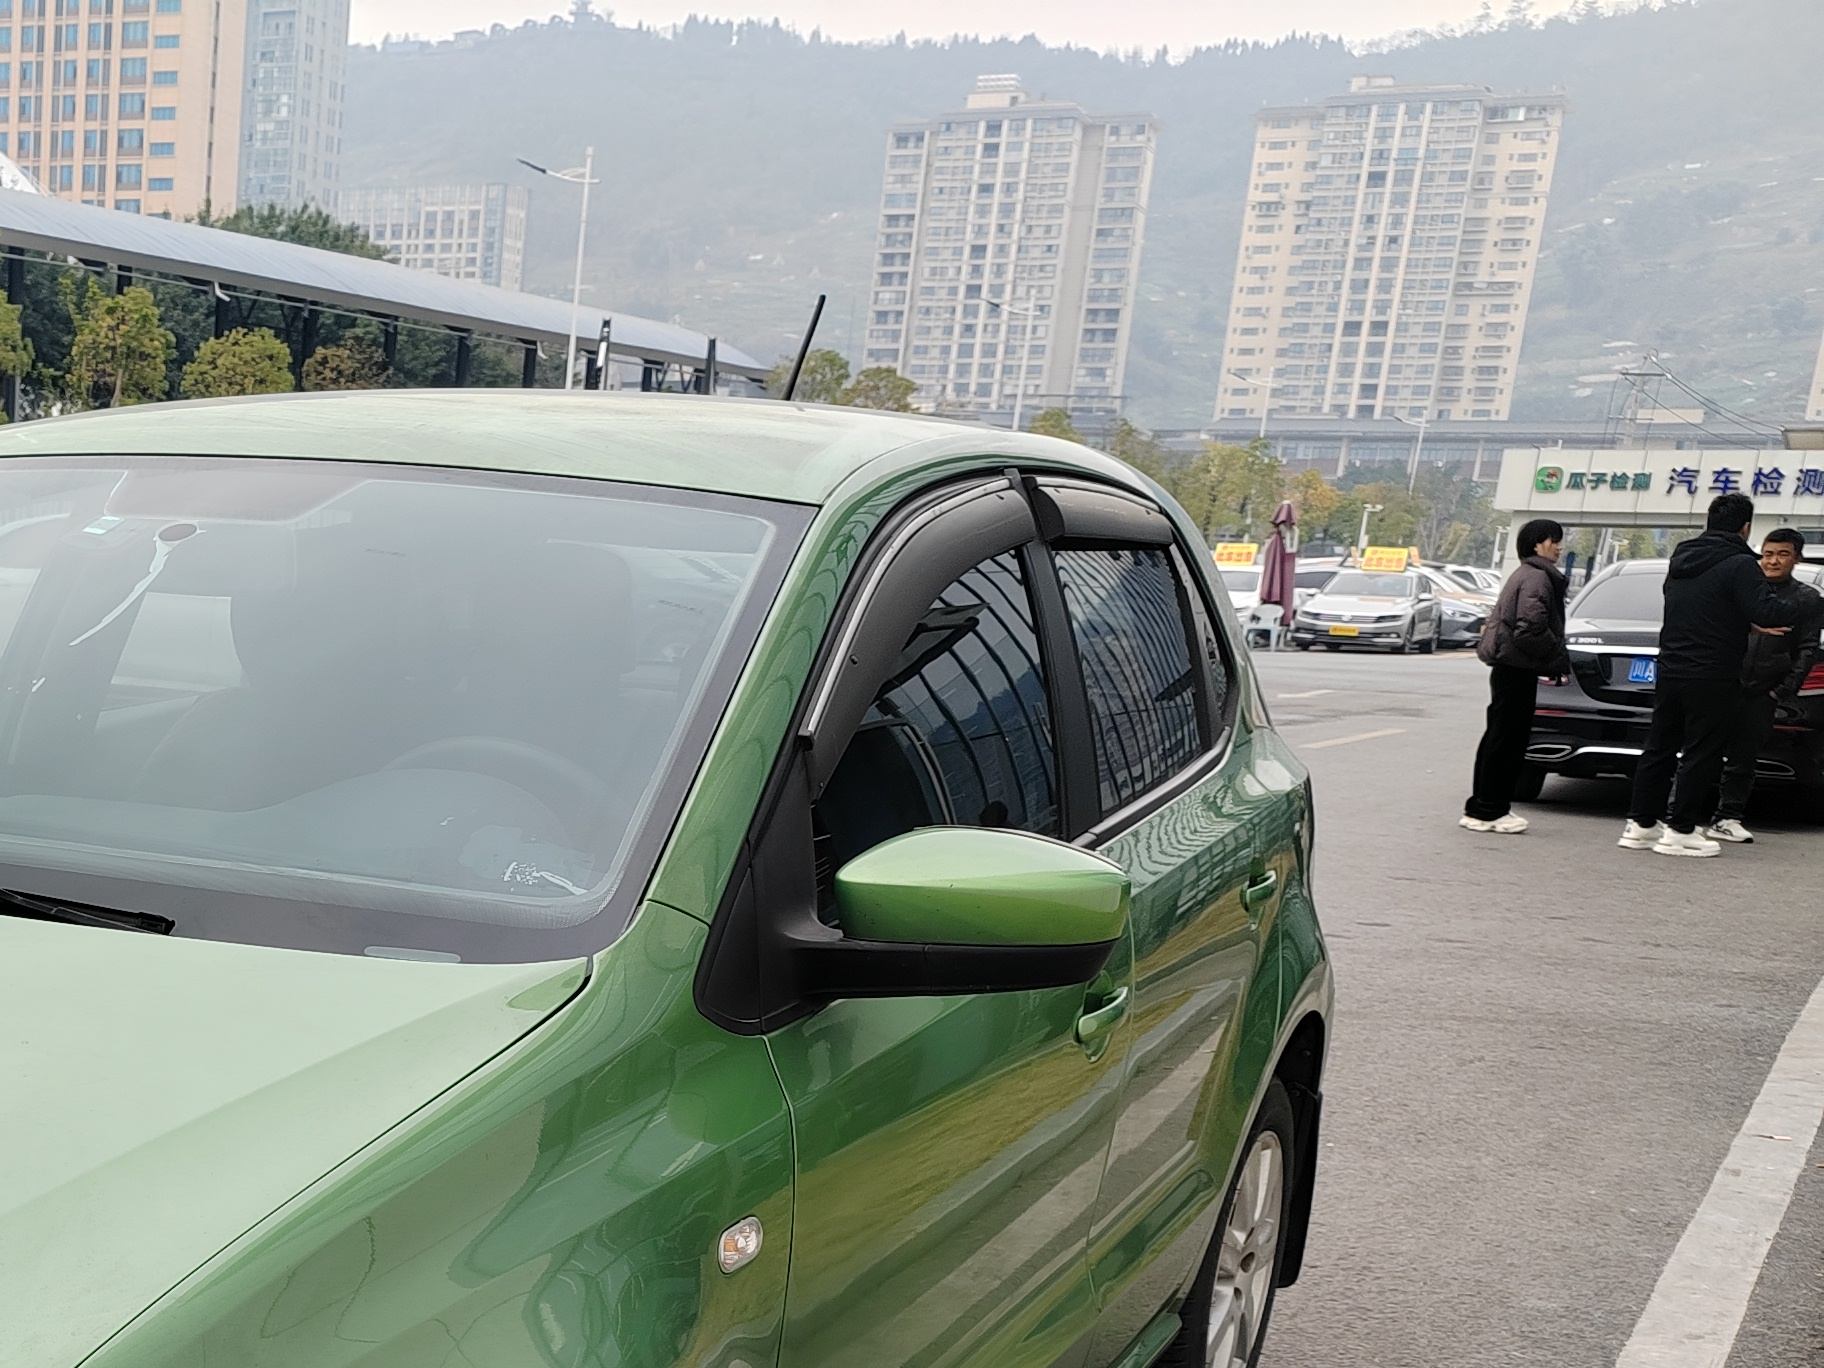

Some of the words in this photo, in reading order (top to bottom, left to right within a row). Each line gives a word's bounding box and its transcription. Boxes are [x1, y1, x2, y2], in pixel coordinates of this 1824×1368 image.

[1566, 471, 1653, 491] 瓜子检测
[1666, 466, 1824, 497] 汽车检测
